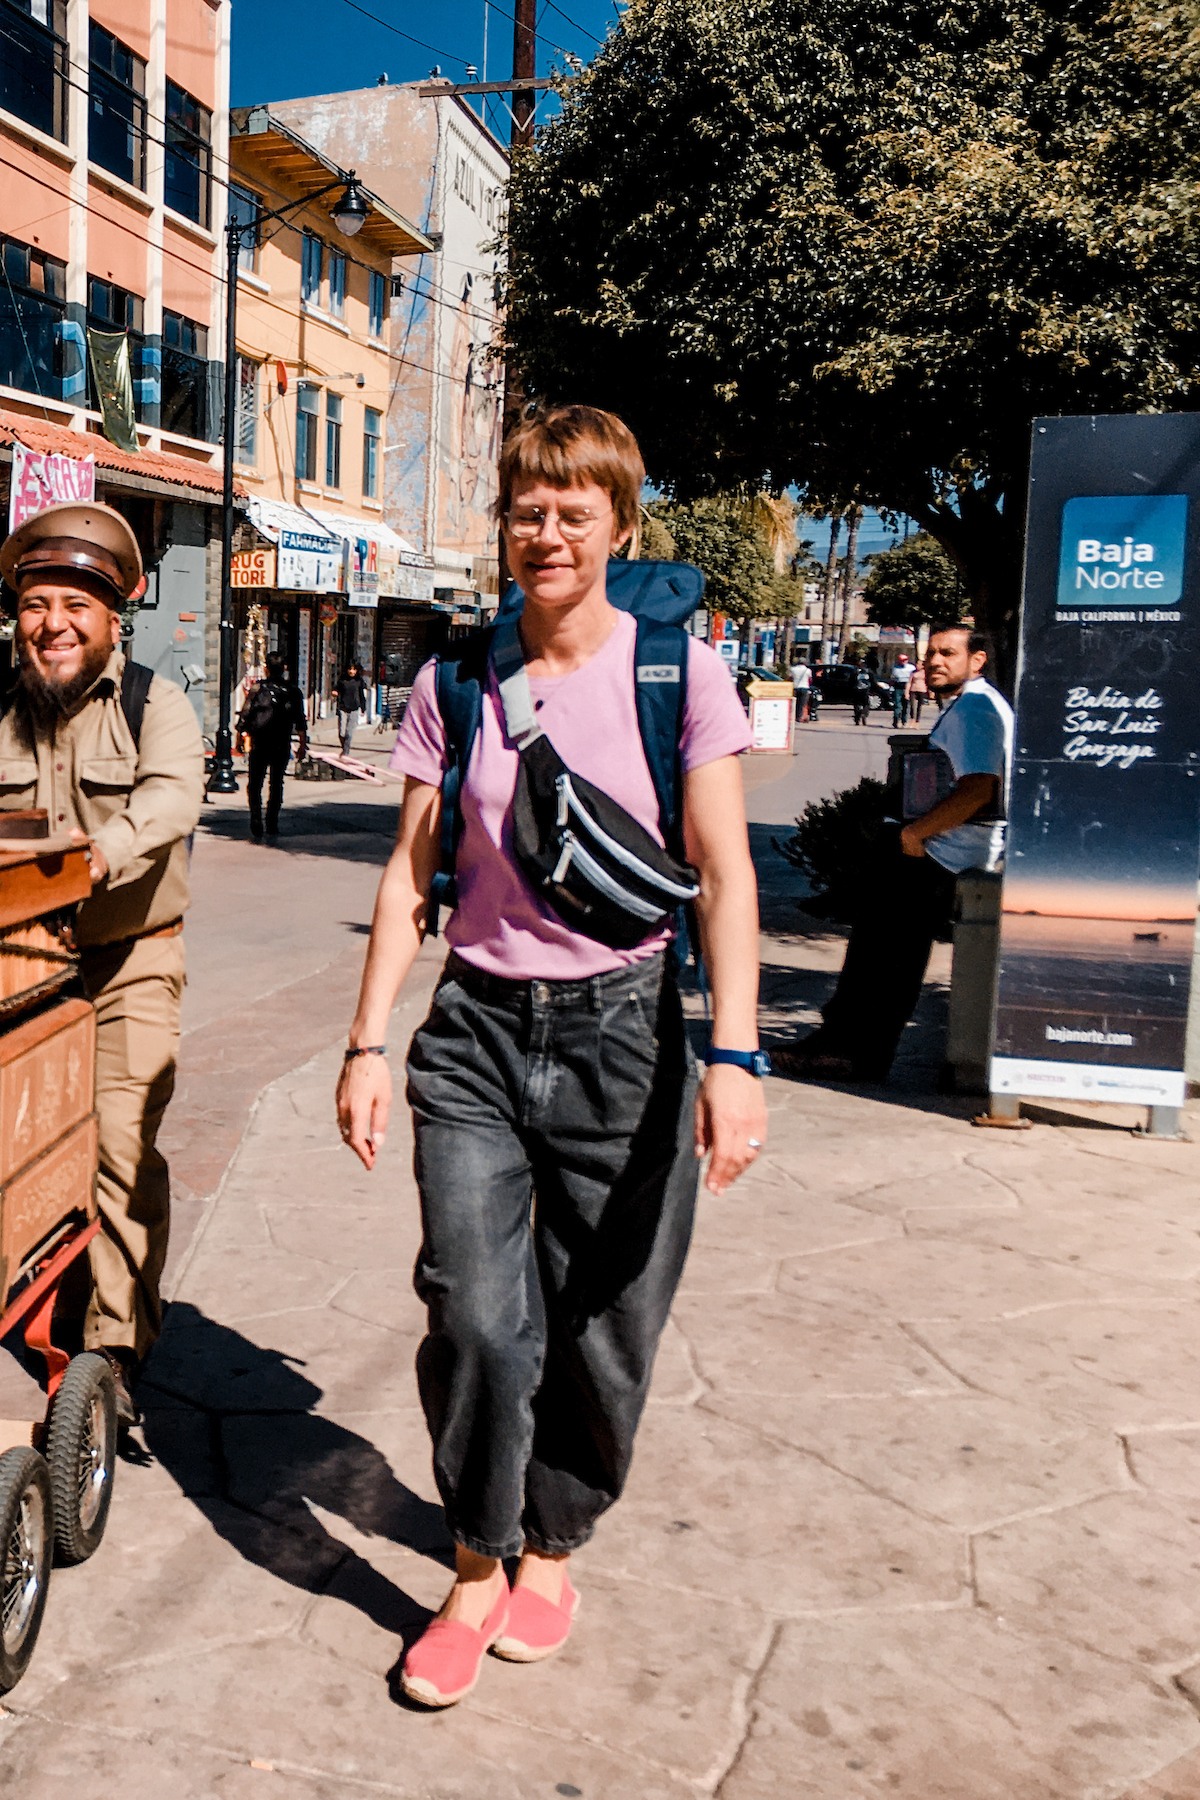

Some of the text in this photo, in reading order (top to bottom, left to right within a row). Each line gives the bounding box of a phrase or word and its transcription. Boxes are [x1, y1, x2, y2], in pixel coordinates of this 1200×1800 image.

[231, 553, 265, 569] RUG
[1077, 536, 1154, 568] Baja
[232, 569, 266, 585] TORE
[1075, 566, 1165, 589] Norte
[1055, 608, 1181, 622] BAJA CALIFORNIA MÉXICO
[1134, 687, 1164, 709] de
[1062, 710, 1163, 735] San Luis
[1063, 735, 1157, 769] Gonzaga
[1045, 1025, 1134, 1046] bajanorte.com
